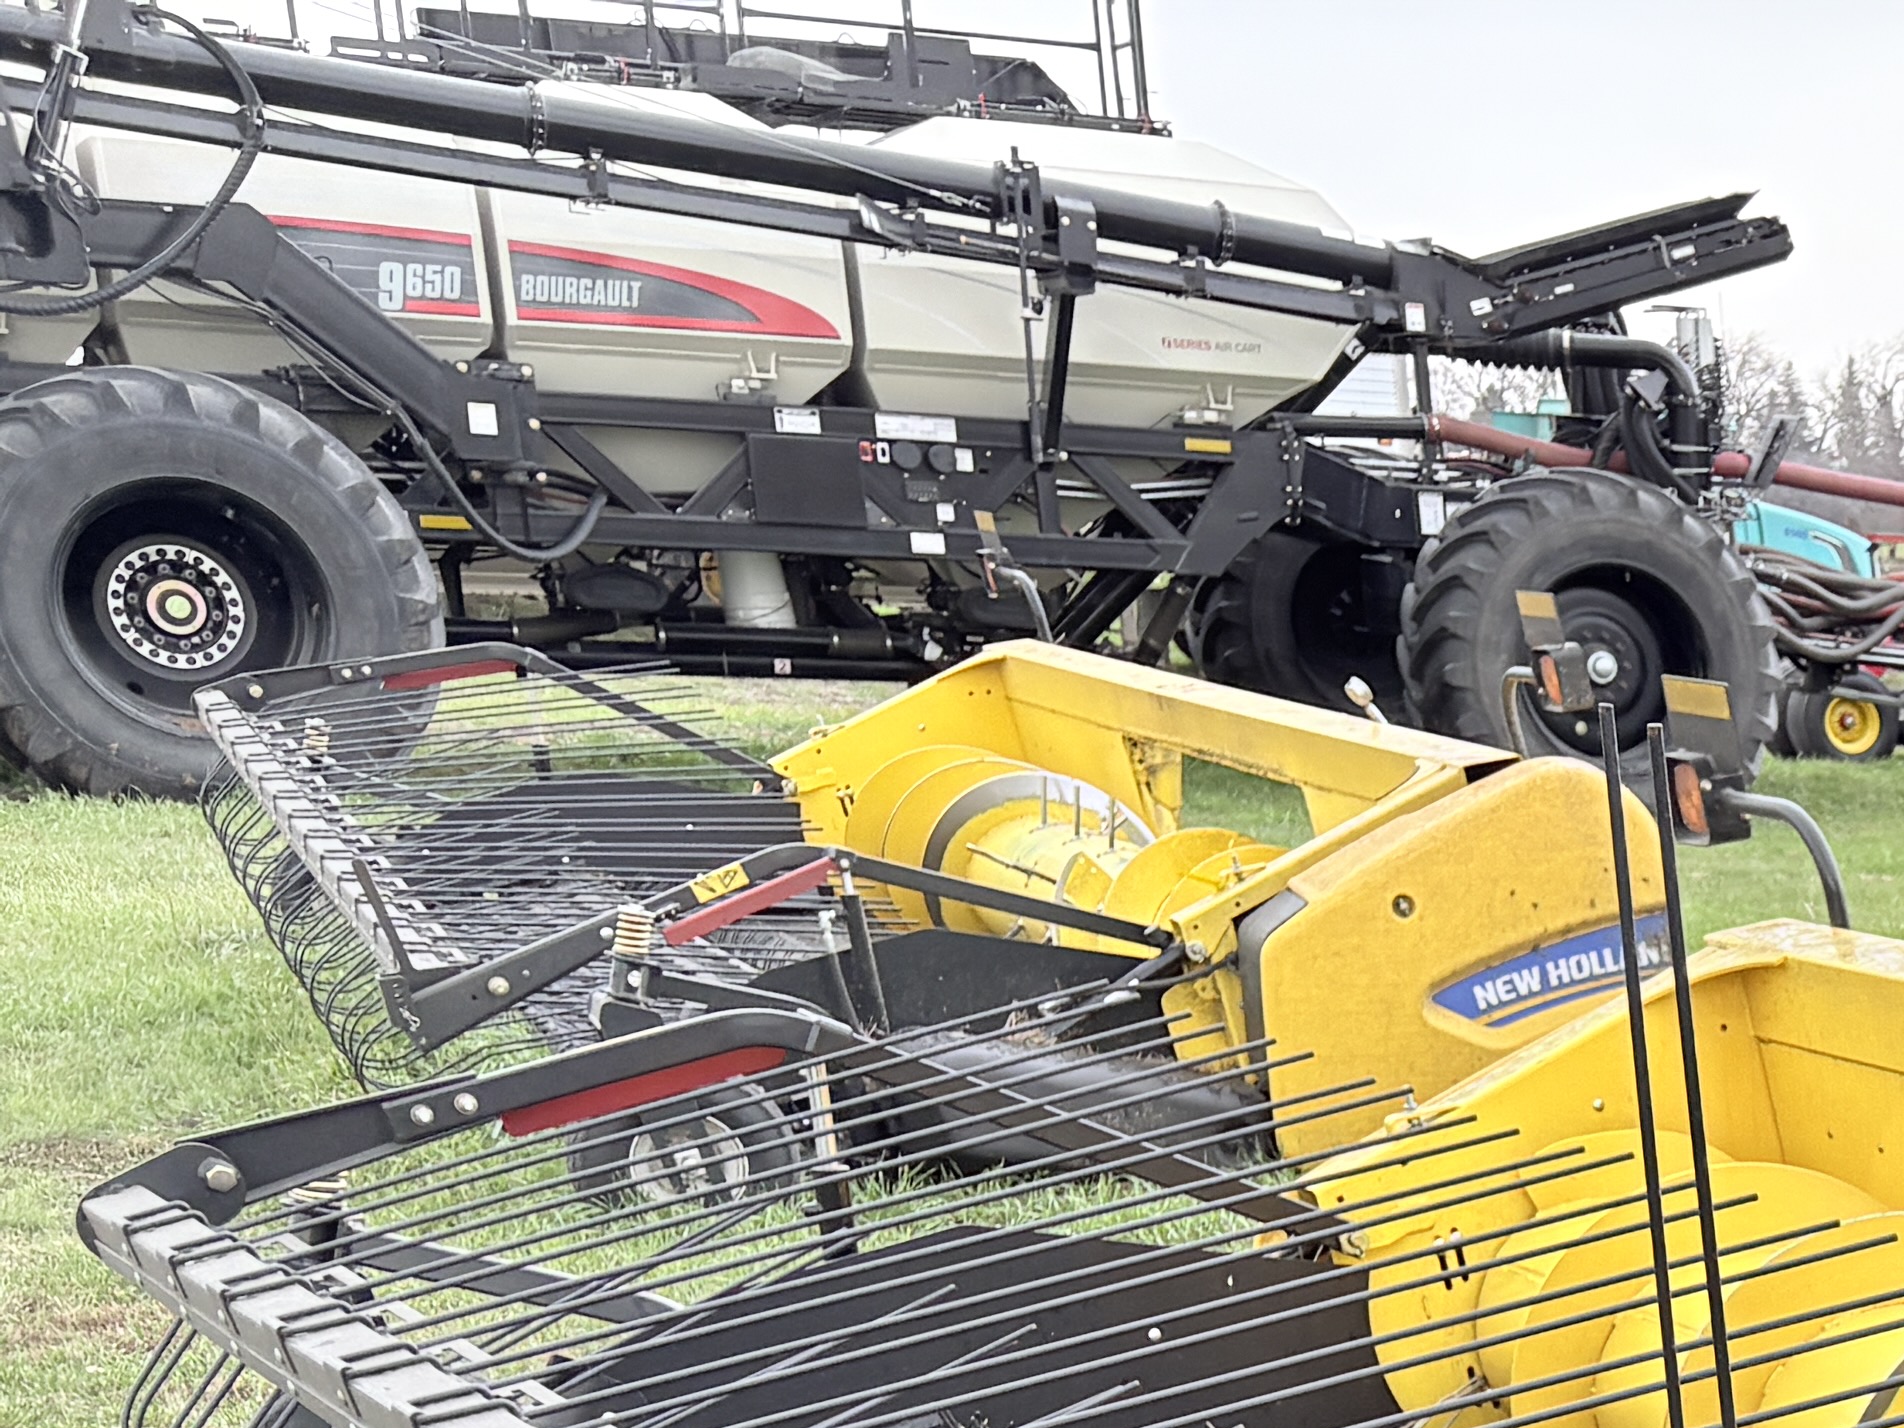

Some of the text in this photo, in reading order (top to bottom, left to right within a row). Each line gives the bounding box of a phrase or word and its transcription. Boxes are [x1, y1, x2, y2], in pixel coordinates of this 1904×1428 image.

[378, 261, 462, 311] 9650
[520, 274, 642, 309] BOURGAULT
[1472, 941, 1672, 1010] NEW HOLLN
